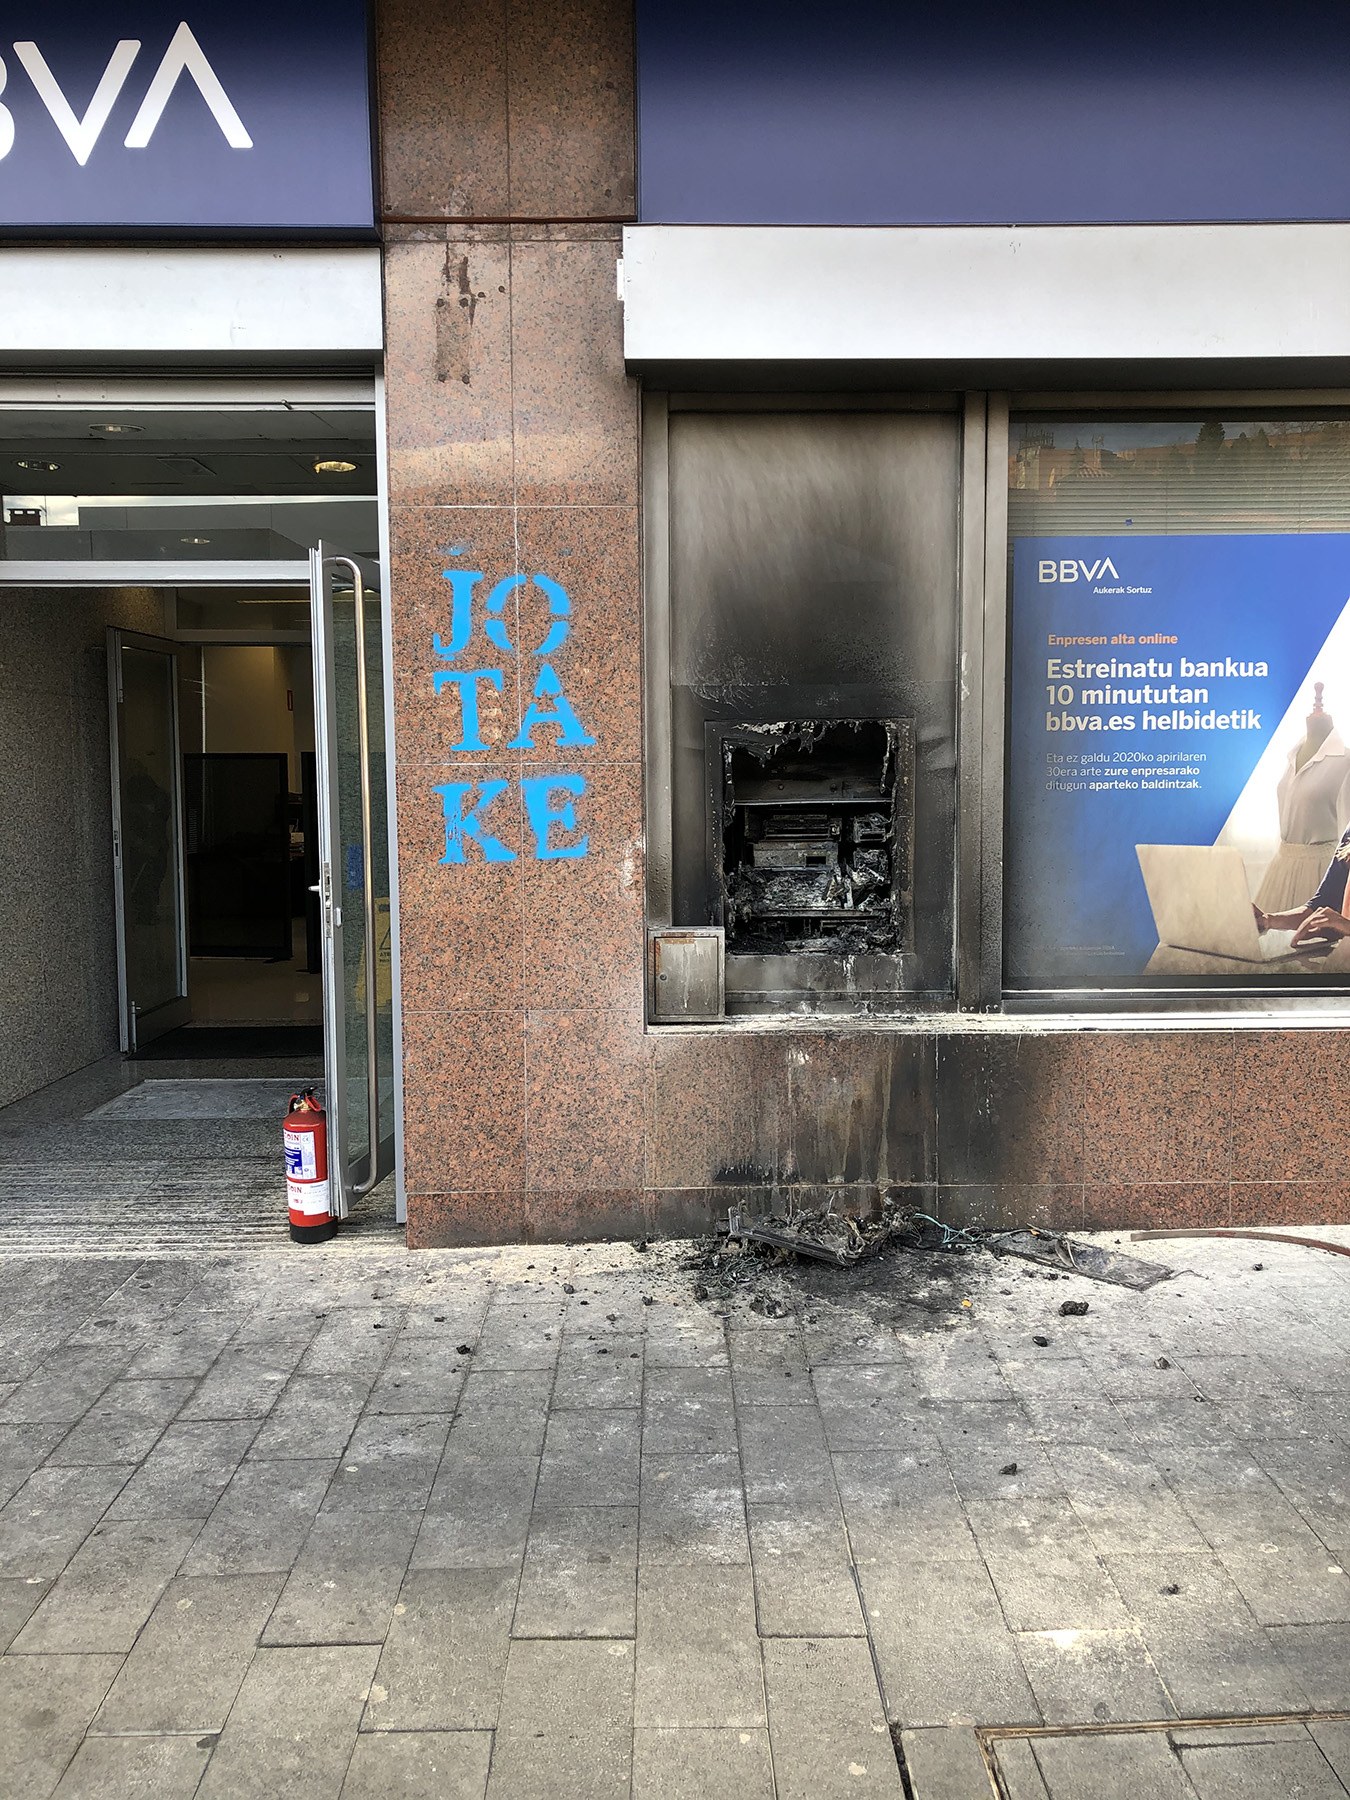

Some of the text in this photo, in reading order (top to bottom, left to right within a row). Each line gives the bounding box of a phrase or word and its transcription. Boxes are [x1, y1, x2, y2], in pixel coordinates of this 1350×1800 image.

[0, 21, 254, 166] VA
[1038, 557, 1120, 584] BBVA
[1093, 585, 1153, 595] Aukerak Sortuz
[433, 570, 571, 656] JO
[1047, 633, 1179, 648] Enpresen alta online
[1047, 656, 1269, 680] Estreinatu bankua
[1046, 684, 1209, 706] 10 minututan
[433, 663, 596, 751] TA
[1046, 709, 1262, 732] bbva.es helbidetik
[1046, 751, 1207, 766] Eta ez galdu 2020ko apirilaren
[1046, 765, 1201, 779] 30era arte zure enpresarako
[1045, 777, 1203, 793] ditugun aparteko baldintzak.
[433, 774, 588, 864] KE
